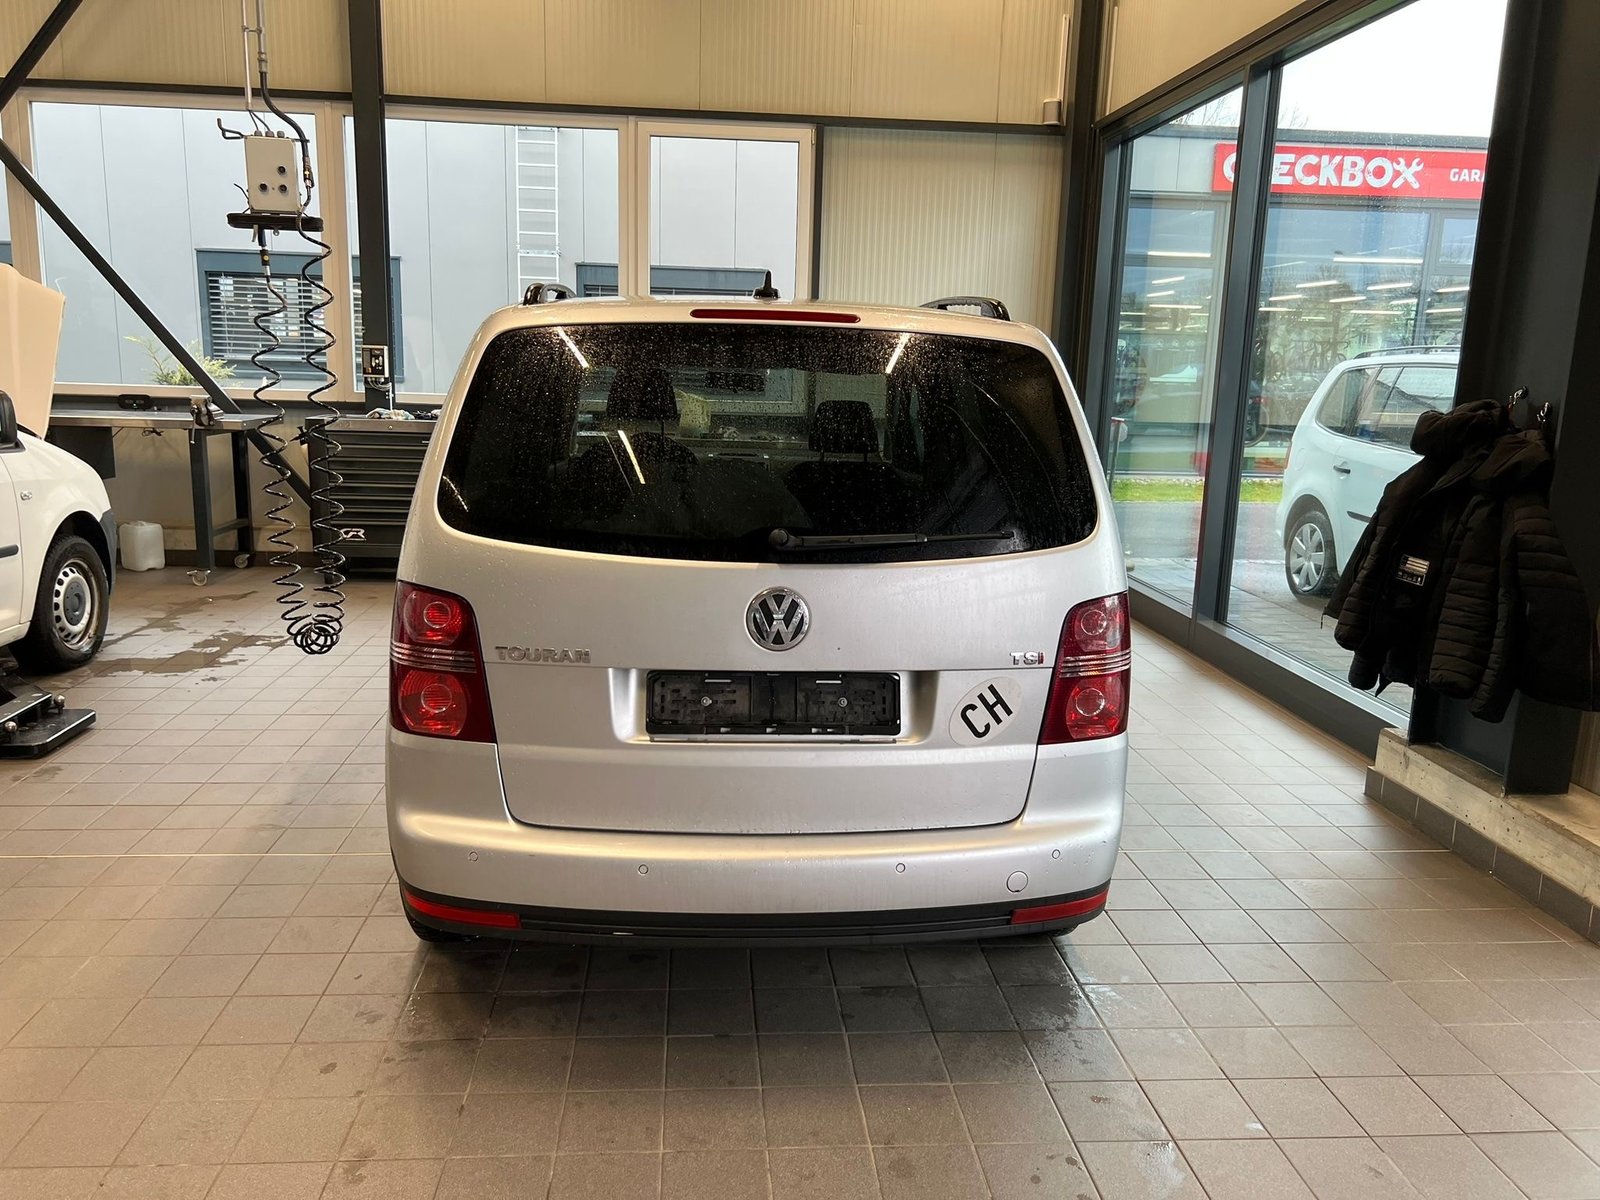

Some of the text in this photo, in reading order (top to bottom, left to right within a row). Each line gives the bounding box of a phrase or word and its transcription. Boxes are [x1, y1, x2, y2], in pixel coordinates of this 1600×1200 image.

[1223, 152, 1424, 189] CECKBOX
[748, 591, 808, 648] VW
[495, 646, 591, 664] TOURAN
[960, 683, 1013, 738] CH
